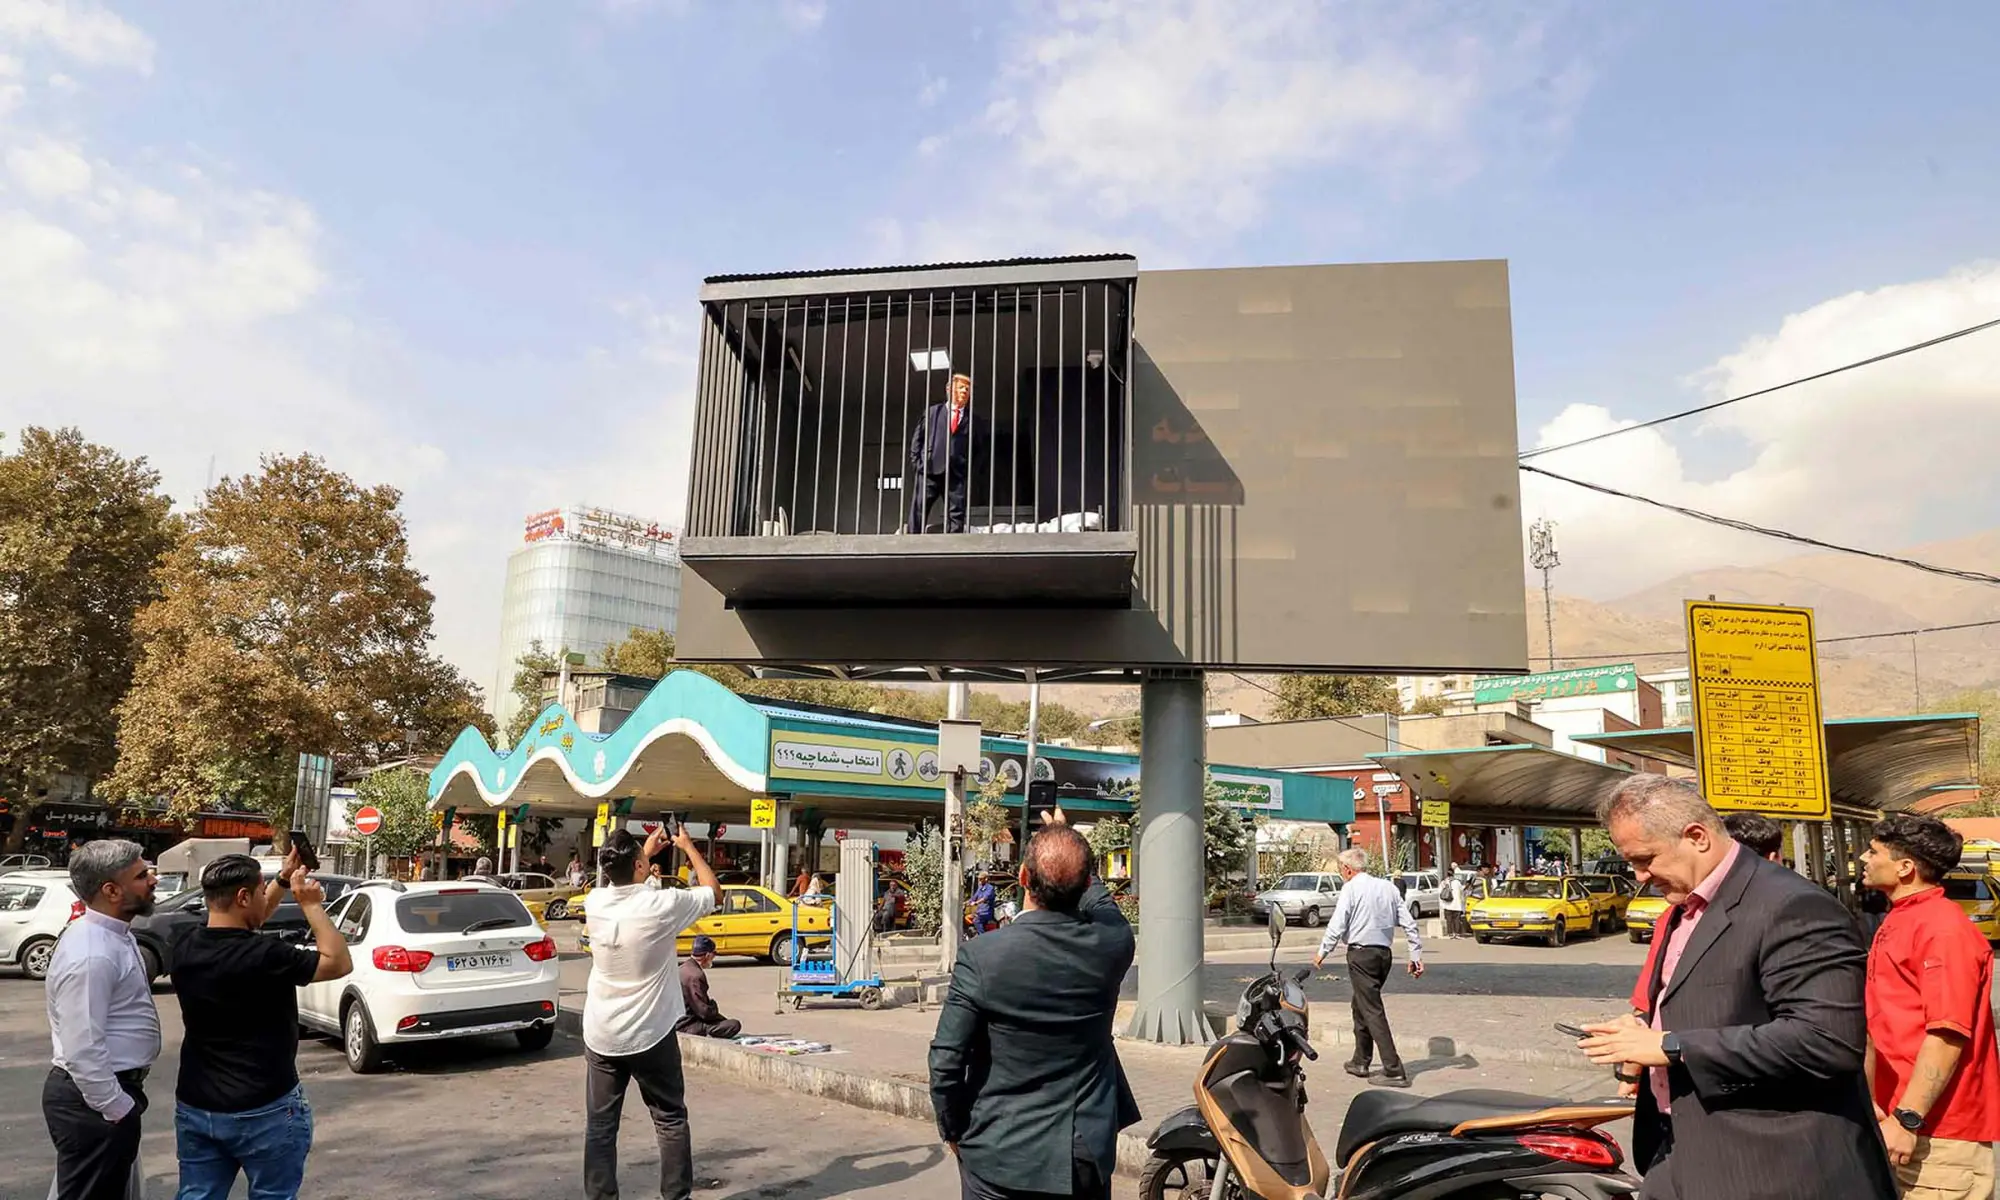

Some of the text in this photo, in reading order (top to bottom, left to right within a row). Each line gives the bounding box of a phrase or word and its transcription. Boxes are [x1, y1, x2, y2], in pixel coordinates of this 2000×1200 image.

[615, 514, 643, 533] خرید
[580, 525, 649, 547] ARG Center
[643, 521, 674, 541] مرکز
[1704, 664, 1716, 672] WC
[817, 751, 840, 764] شما
[841, 755, 879, 768] انتخاب
[67, 812, 95, 823] قهوه
[480, 954, 498, 967] ۱۷۶
